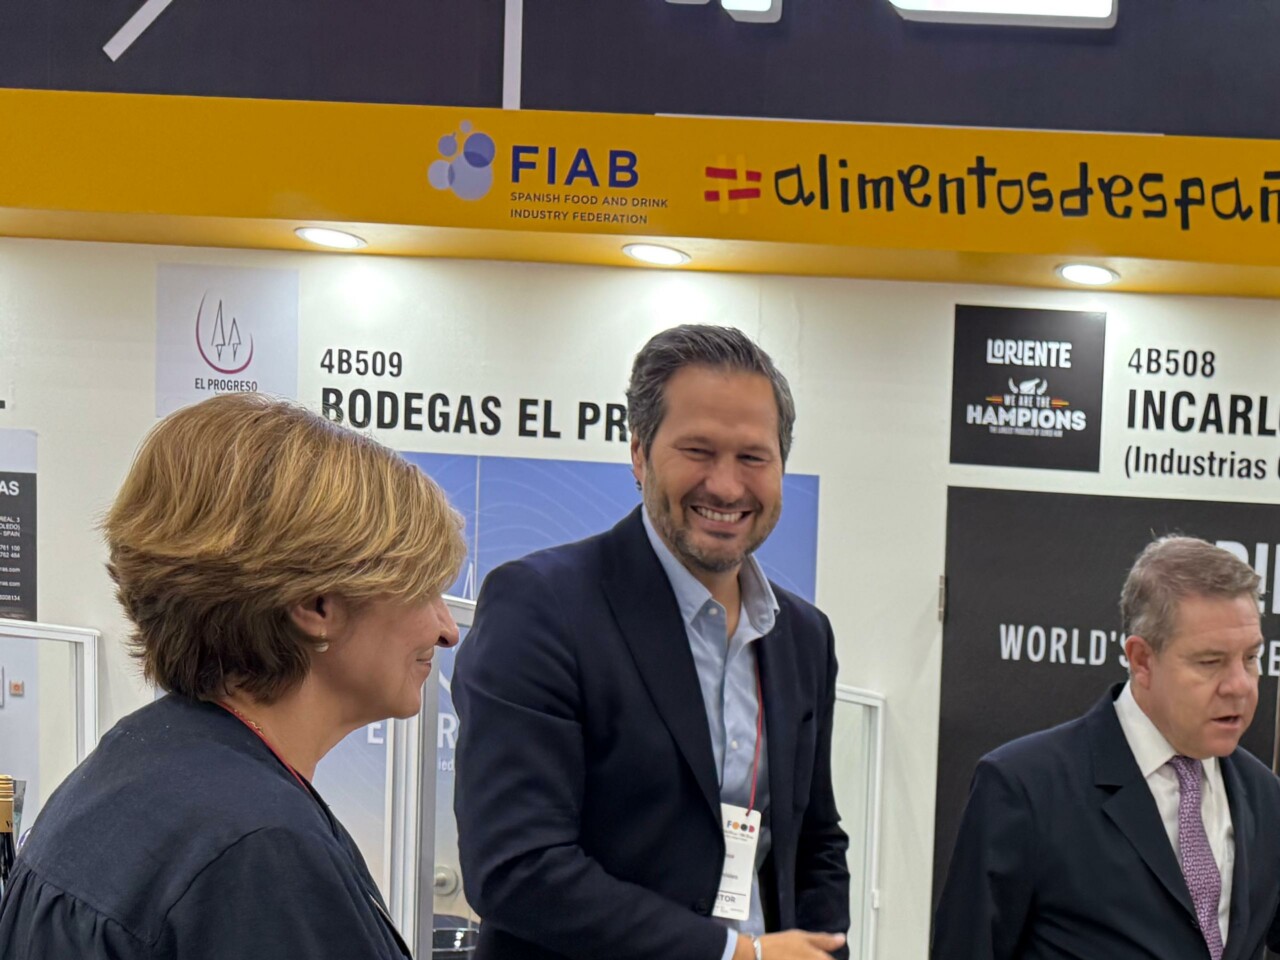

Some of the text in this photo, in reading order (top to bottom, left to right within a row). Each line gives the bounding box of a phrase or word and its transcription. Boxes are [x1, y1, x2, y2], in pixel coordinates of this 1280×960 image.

[511, 144, 640, 188] FIAB
[510, 192, 668, 209] SPANISH FOOD AND DRINK
[510, 208, 648, 225] INDUSTRY FEDERATION
[320, 348, 402, 377] 4B509
[986, 338, 1072, 368] LORIENTE
[1128, 347, 1216, 377] 4B508
[195, 378, 258, 392] EL PROGRESO
[322, 387, 502, 436] BODEGAS
[518, 397, 562, 439] EL
[966, 404, 1087, 431] HAMPIONS
[1124, 445, 1267, 480] (Industrias
